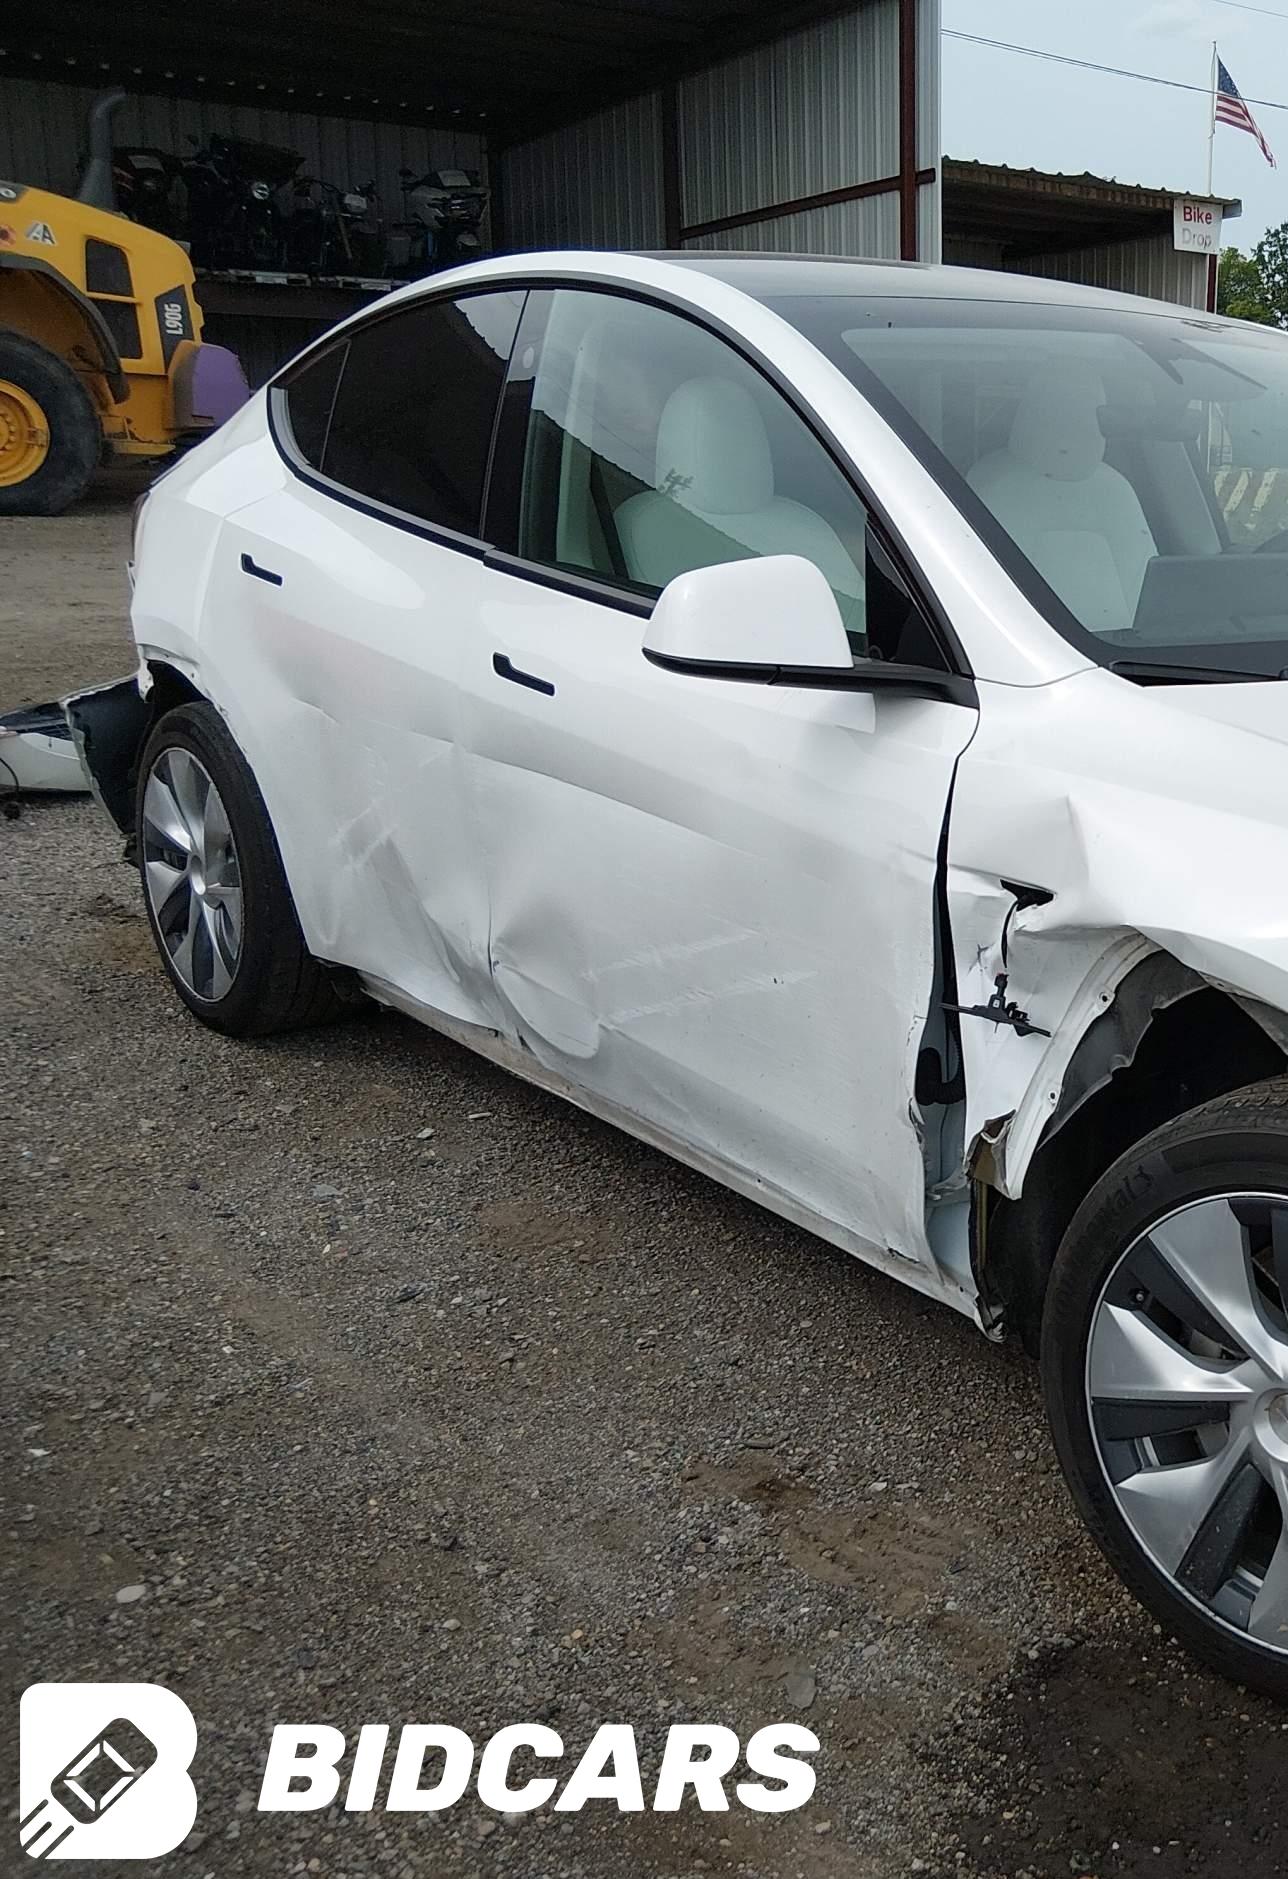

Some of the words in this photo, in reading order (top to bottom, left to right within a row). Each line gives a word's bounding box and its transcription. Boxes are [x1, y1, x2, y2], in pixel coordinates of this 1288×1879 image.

[1183, 206, 1213, 225] Bike
[1182, 228, 1212, 249] Drop
[163, 302, 184, 336] L90G
